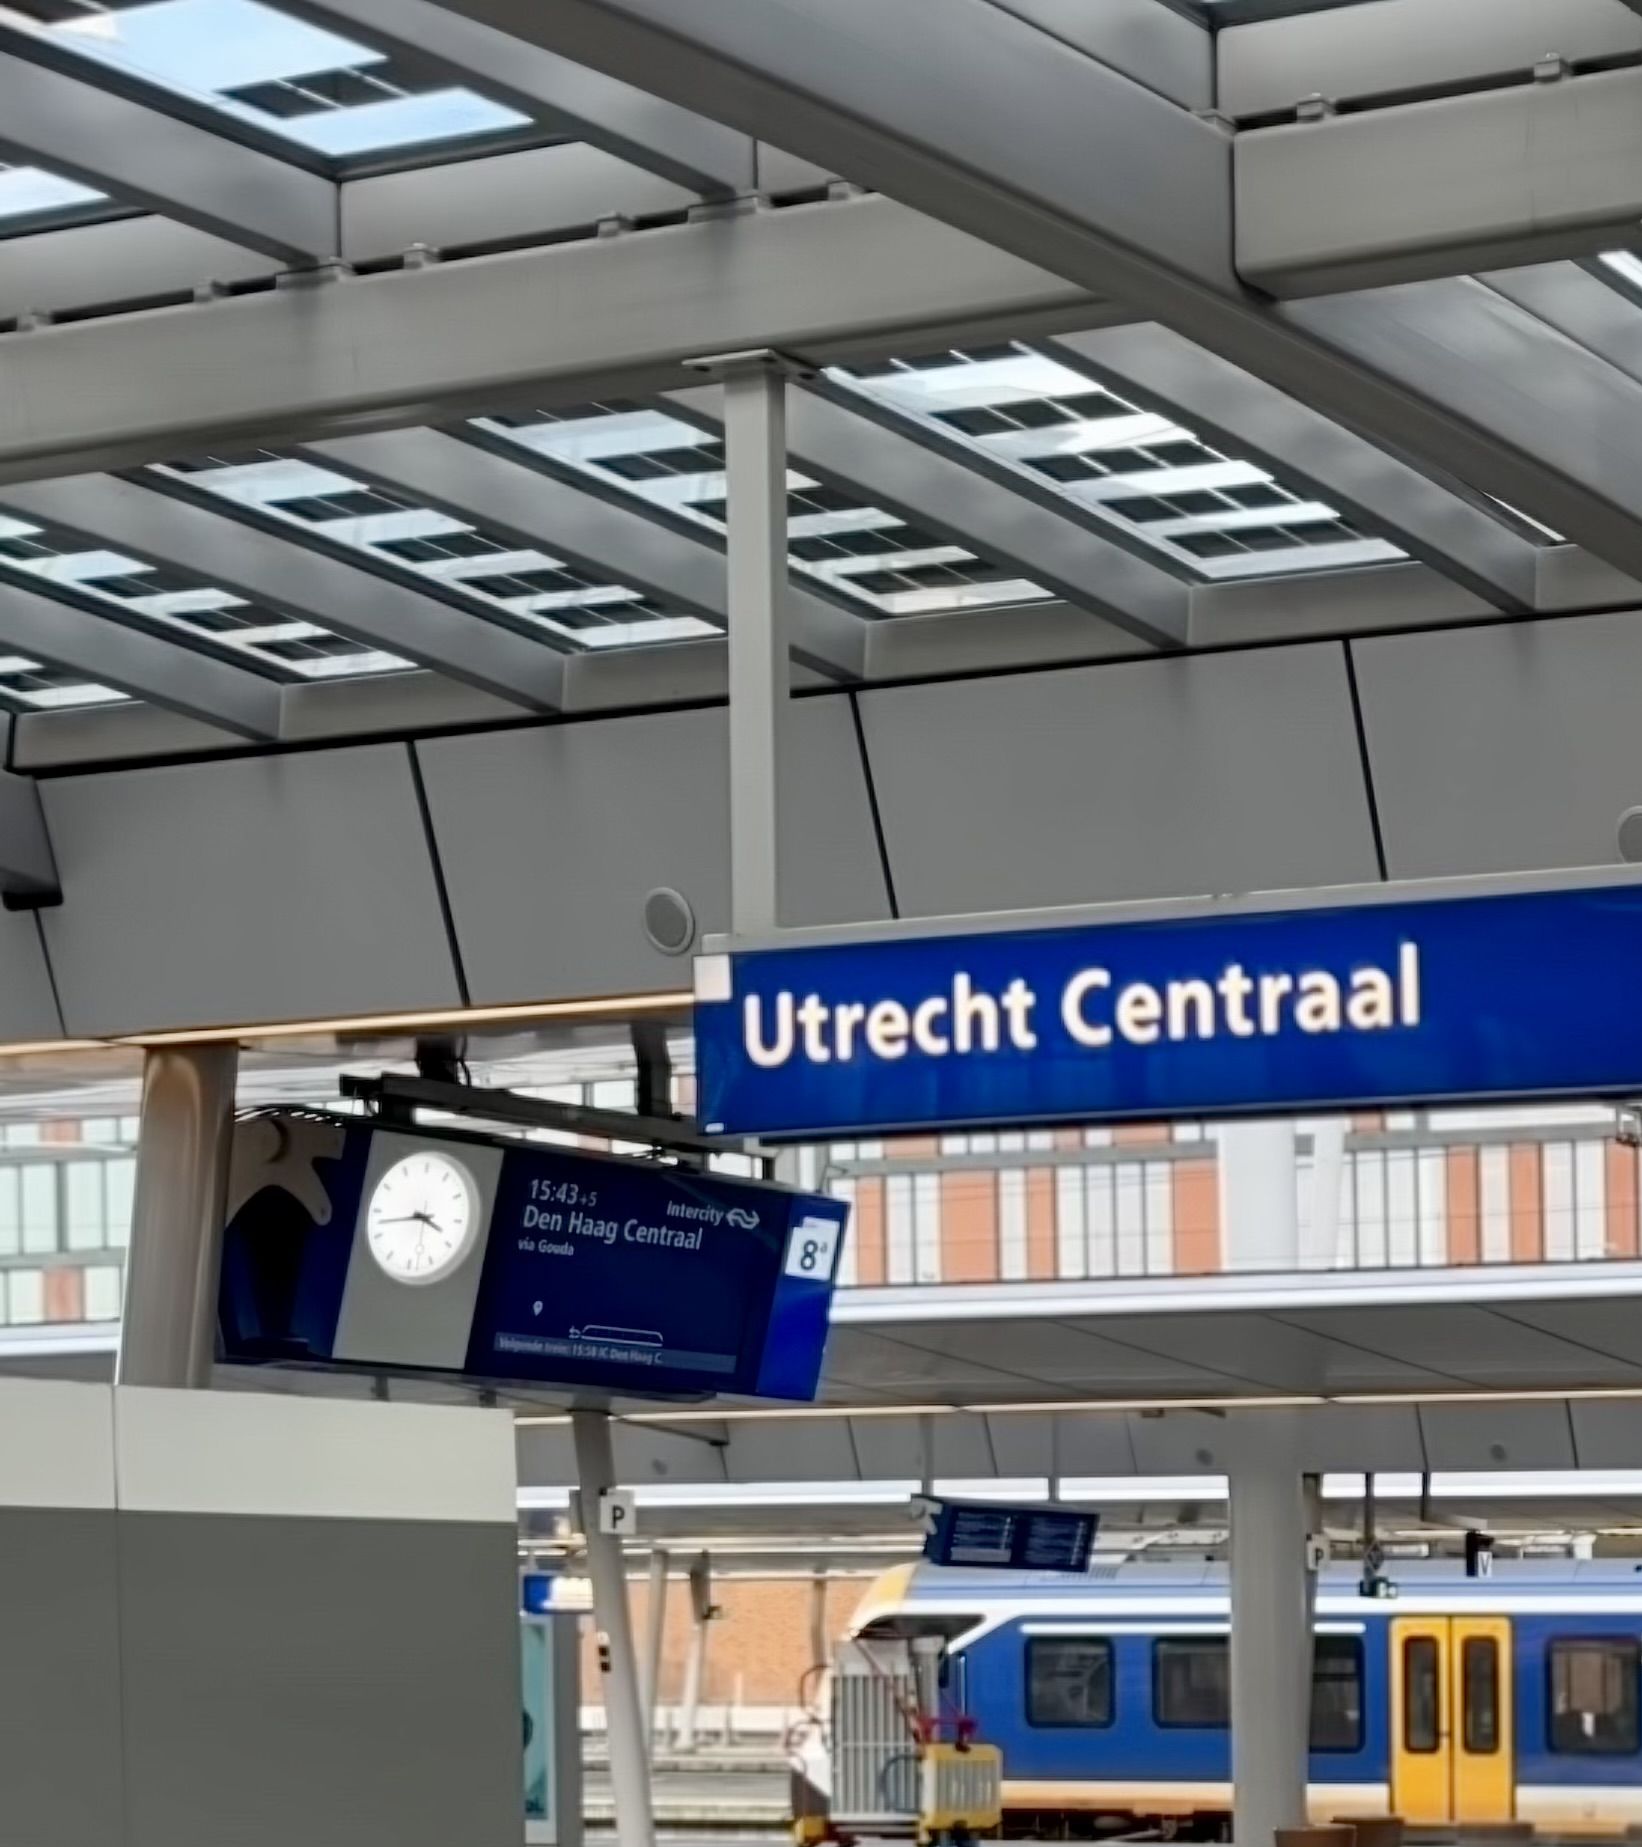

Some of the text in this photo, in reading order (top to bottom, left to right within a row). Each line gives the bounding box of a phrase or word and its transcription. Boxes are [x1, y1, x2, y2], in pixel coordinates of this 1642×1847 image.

[742, 941, 1421, 1069] Utrecht Centraal
[667, 1200, 724, 1226] Intercity
[523, 1205, 703, 1250] Den Haag Centraal
[518, 1237, 574, 1256] via Gouda
[612, 1504, 625, 1529] P
